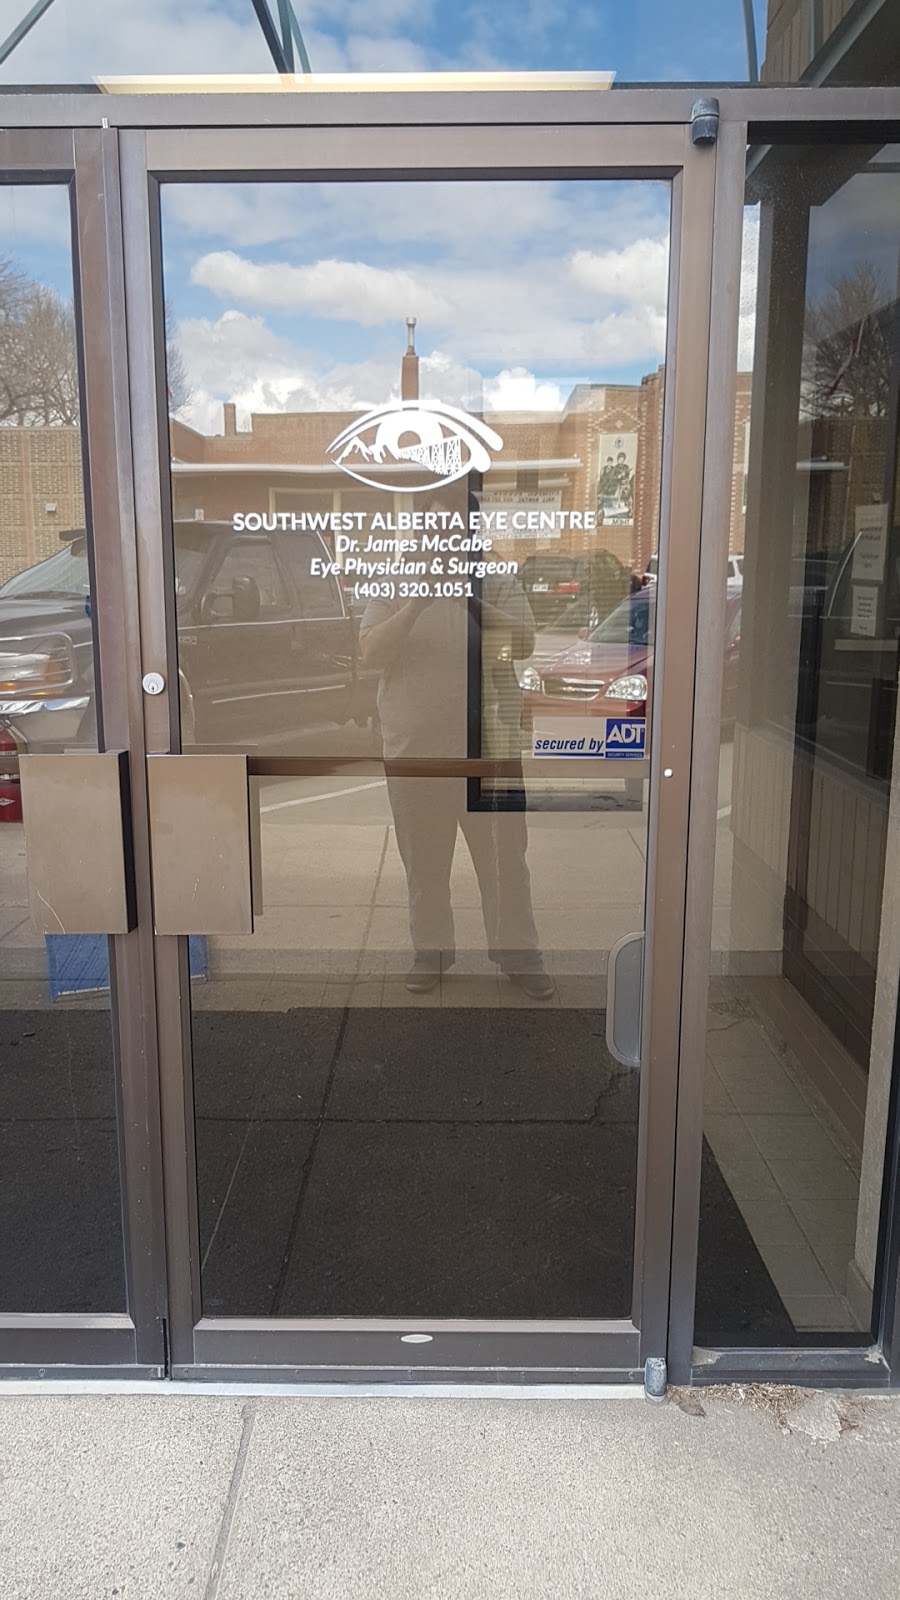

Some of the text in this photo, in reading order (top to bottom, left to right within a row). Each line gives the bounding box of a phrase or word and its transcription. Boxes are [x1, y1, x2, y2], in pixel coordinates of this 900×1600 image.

[232, 511, 596, 531] SOUTHWEST ALBERTA EYE CENTRE
[336, 534, 493, 553] Dr. James McCabe
[310, 557, 518, 579] Eye Physician & Surgeon
[354, 582, 474, 600] (403) 320.1051
[606, 723, 646, 744] ADT
[535, 738, 604, 753] secured by
